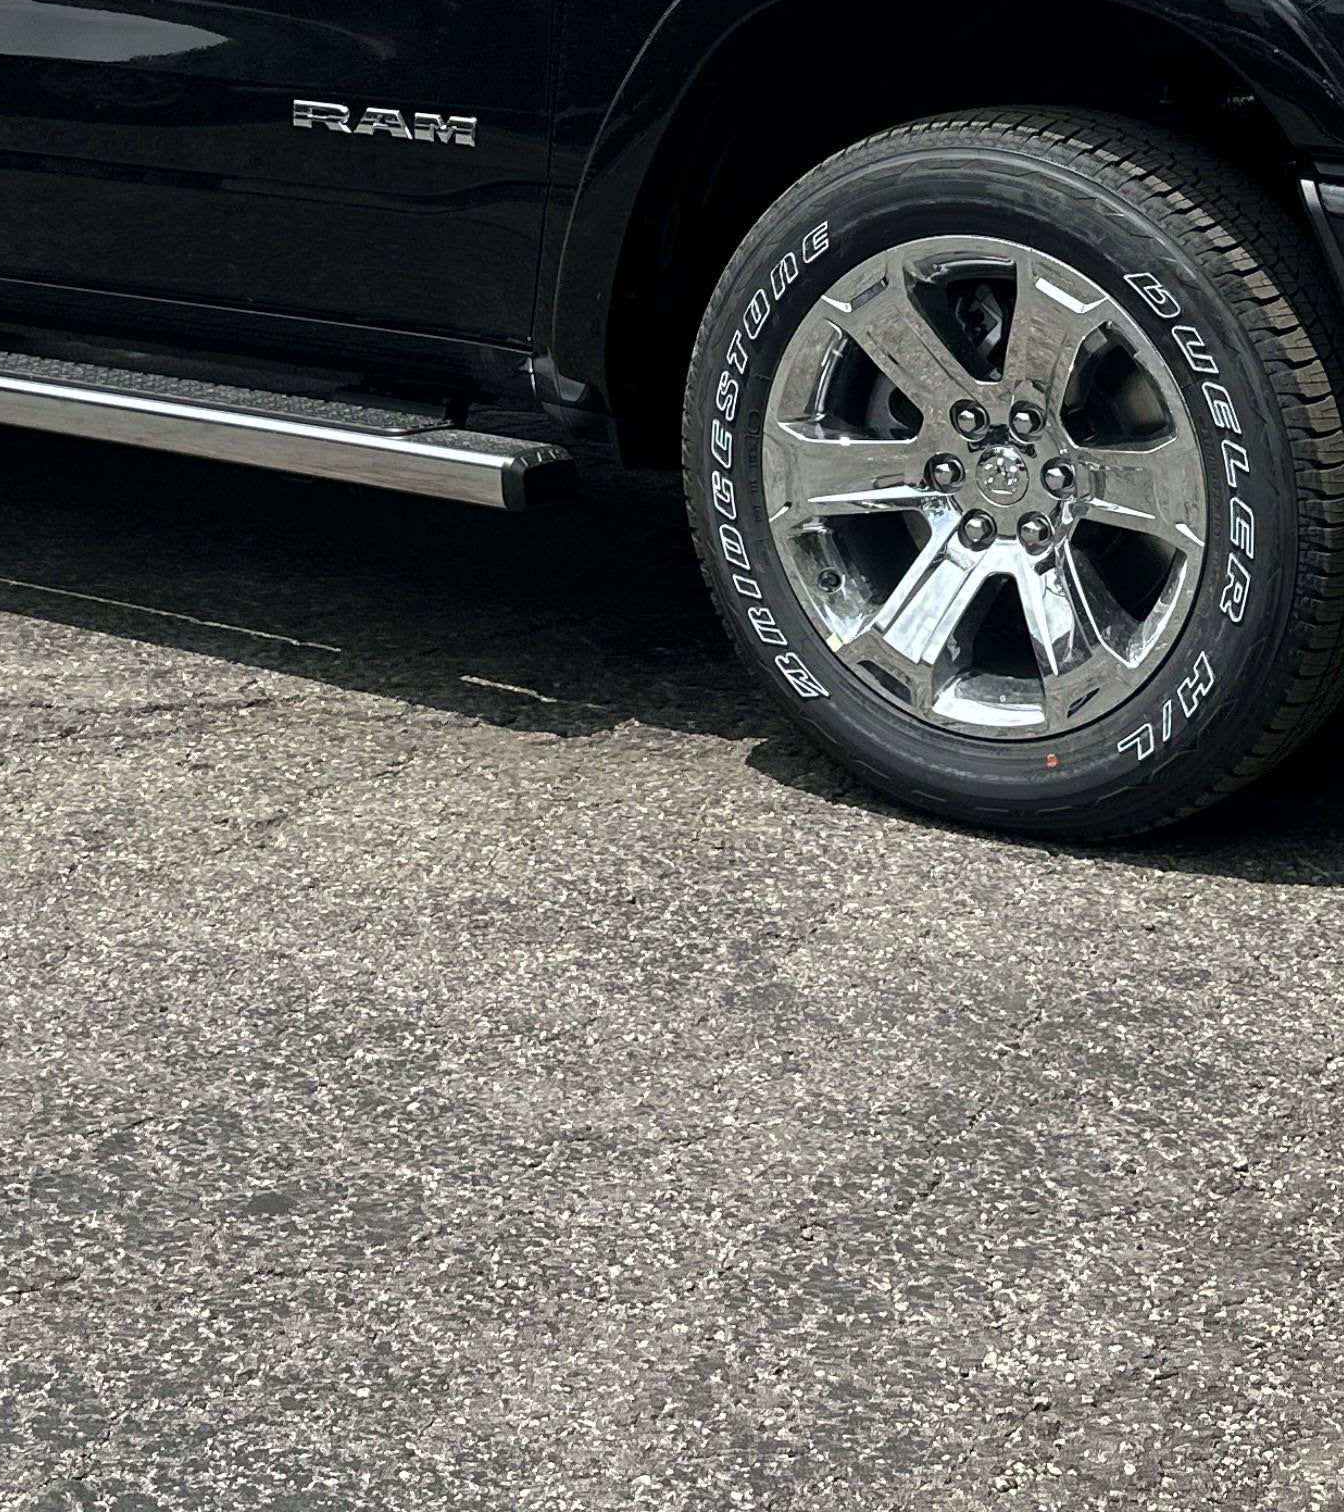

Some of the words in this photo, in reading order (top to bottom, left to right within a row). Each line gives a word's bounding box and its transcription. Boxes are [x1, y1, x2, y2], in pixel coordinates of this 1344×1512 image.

[293, 99, 477, 147] RAM
[707, 220, 831, 701] BRIDGESTONE
[1124, 271, 1257, 625] DUELER
[1117, 650, 1215, 761] H/L
